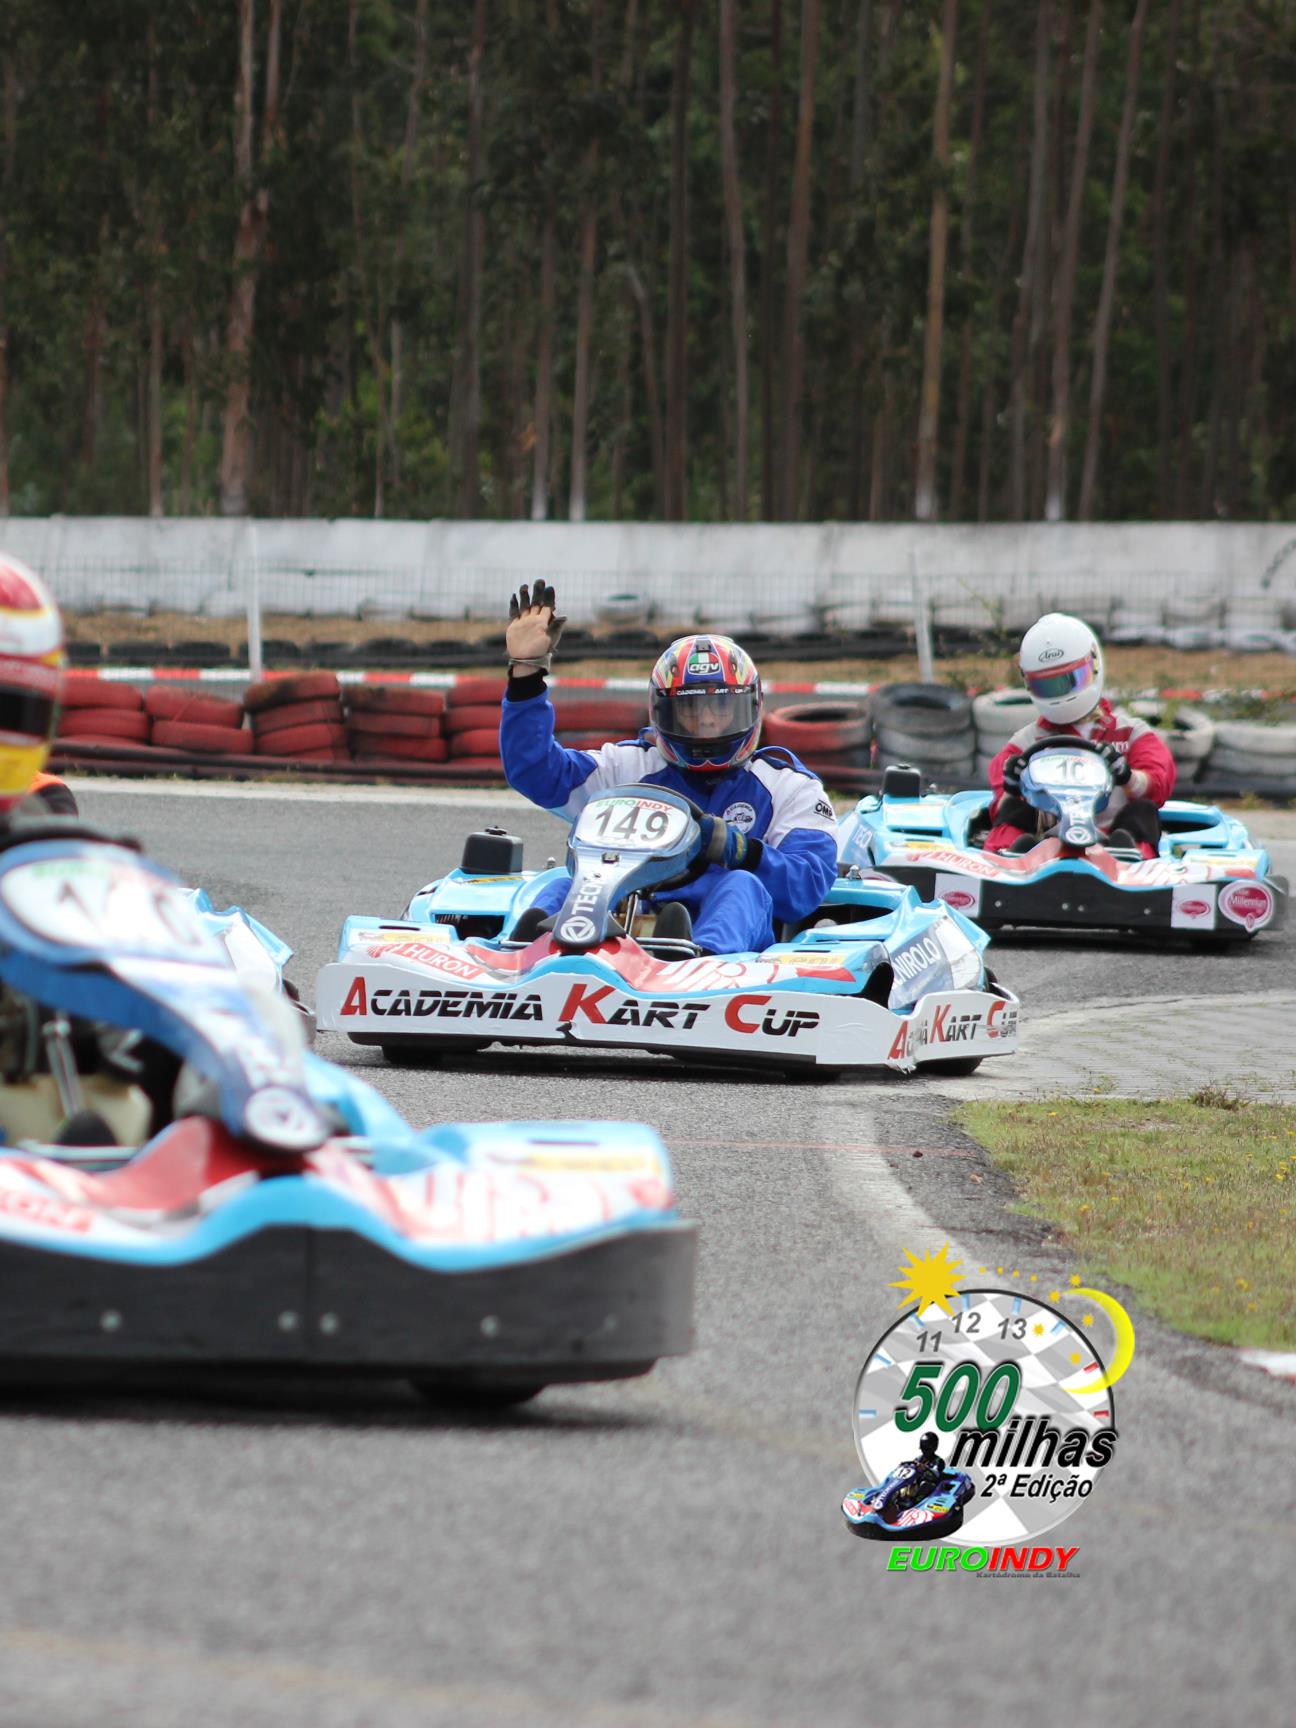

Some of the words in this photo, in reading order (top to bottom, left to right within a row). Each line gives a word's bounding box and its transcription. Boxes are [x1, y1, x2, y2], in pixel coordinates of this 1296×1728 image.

[689, 662, 719, 673] agv
[594, 804, 669, 842] 149
[814, 802, 834, 817] OMP
[404, 945, 477, 977] HURON
[340, 976, 544, 1021] ACADEMIA
[559, 983, 710, 1029] KART
[725, 994, 821, 1037] CUP
[929, 1004, 982, 1043] KART
